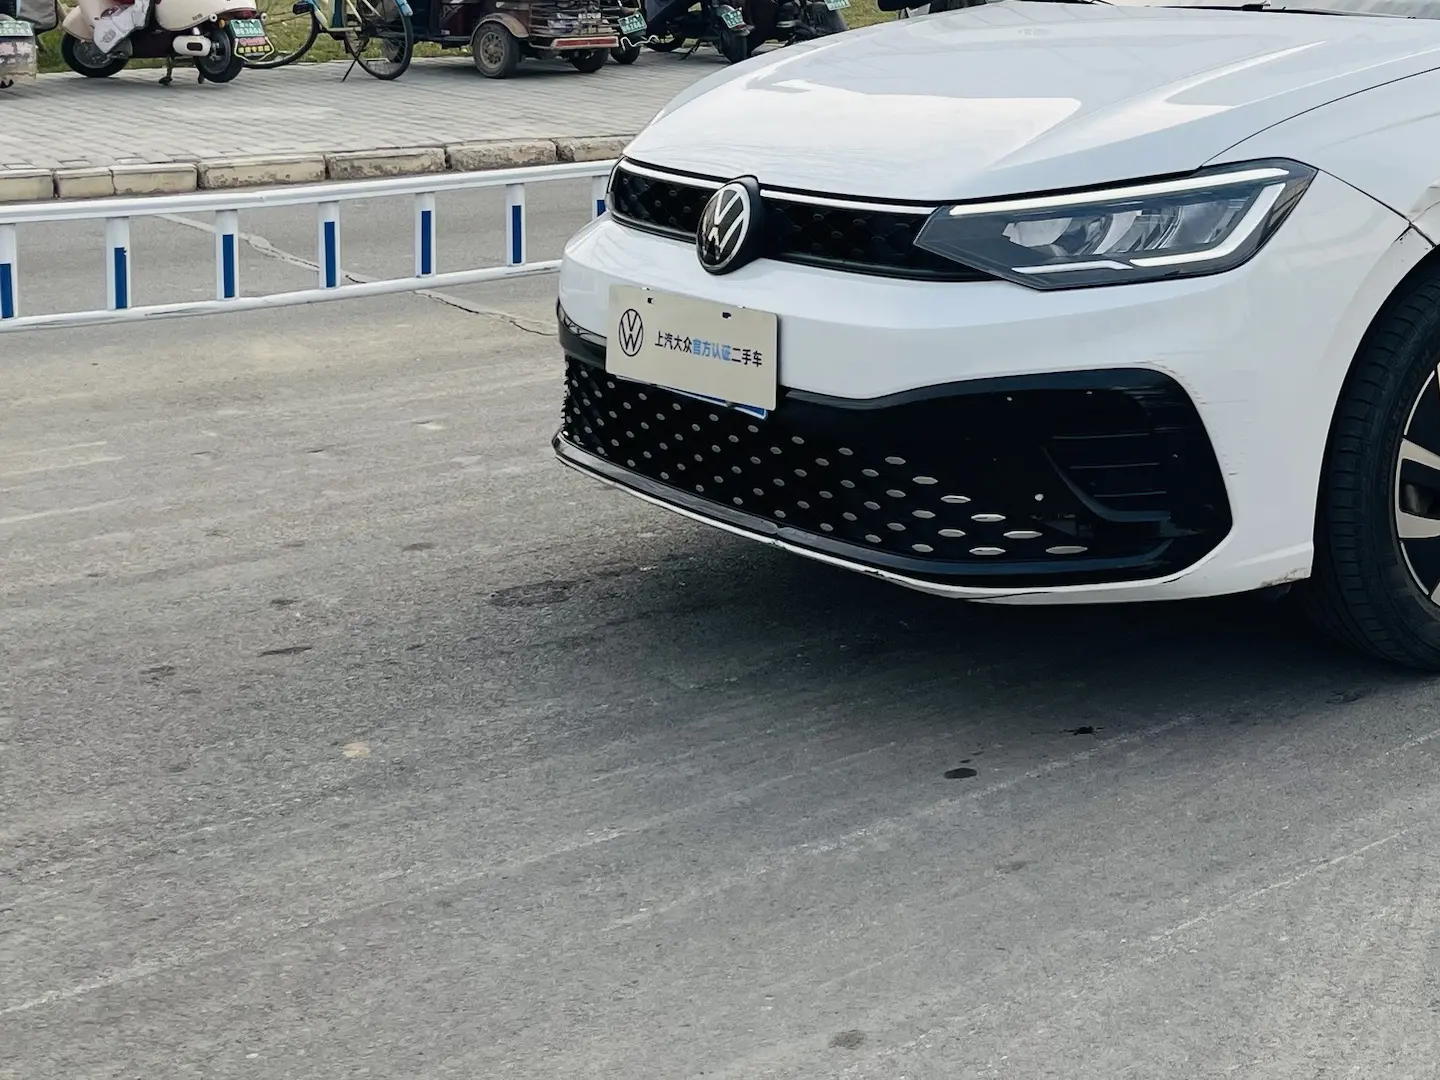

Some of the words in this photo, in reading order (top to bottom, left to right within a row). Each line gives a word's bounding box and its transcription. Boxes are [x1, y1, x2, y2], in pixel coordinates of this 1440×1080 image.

[655, 331, 763, 367] 上汽大众官方认证二手车
